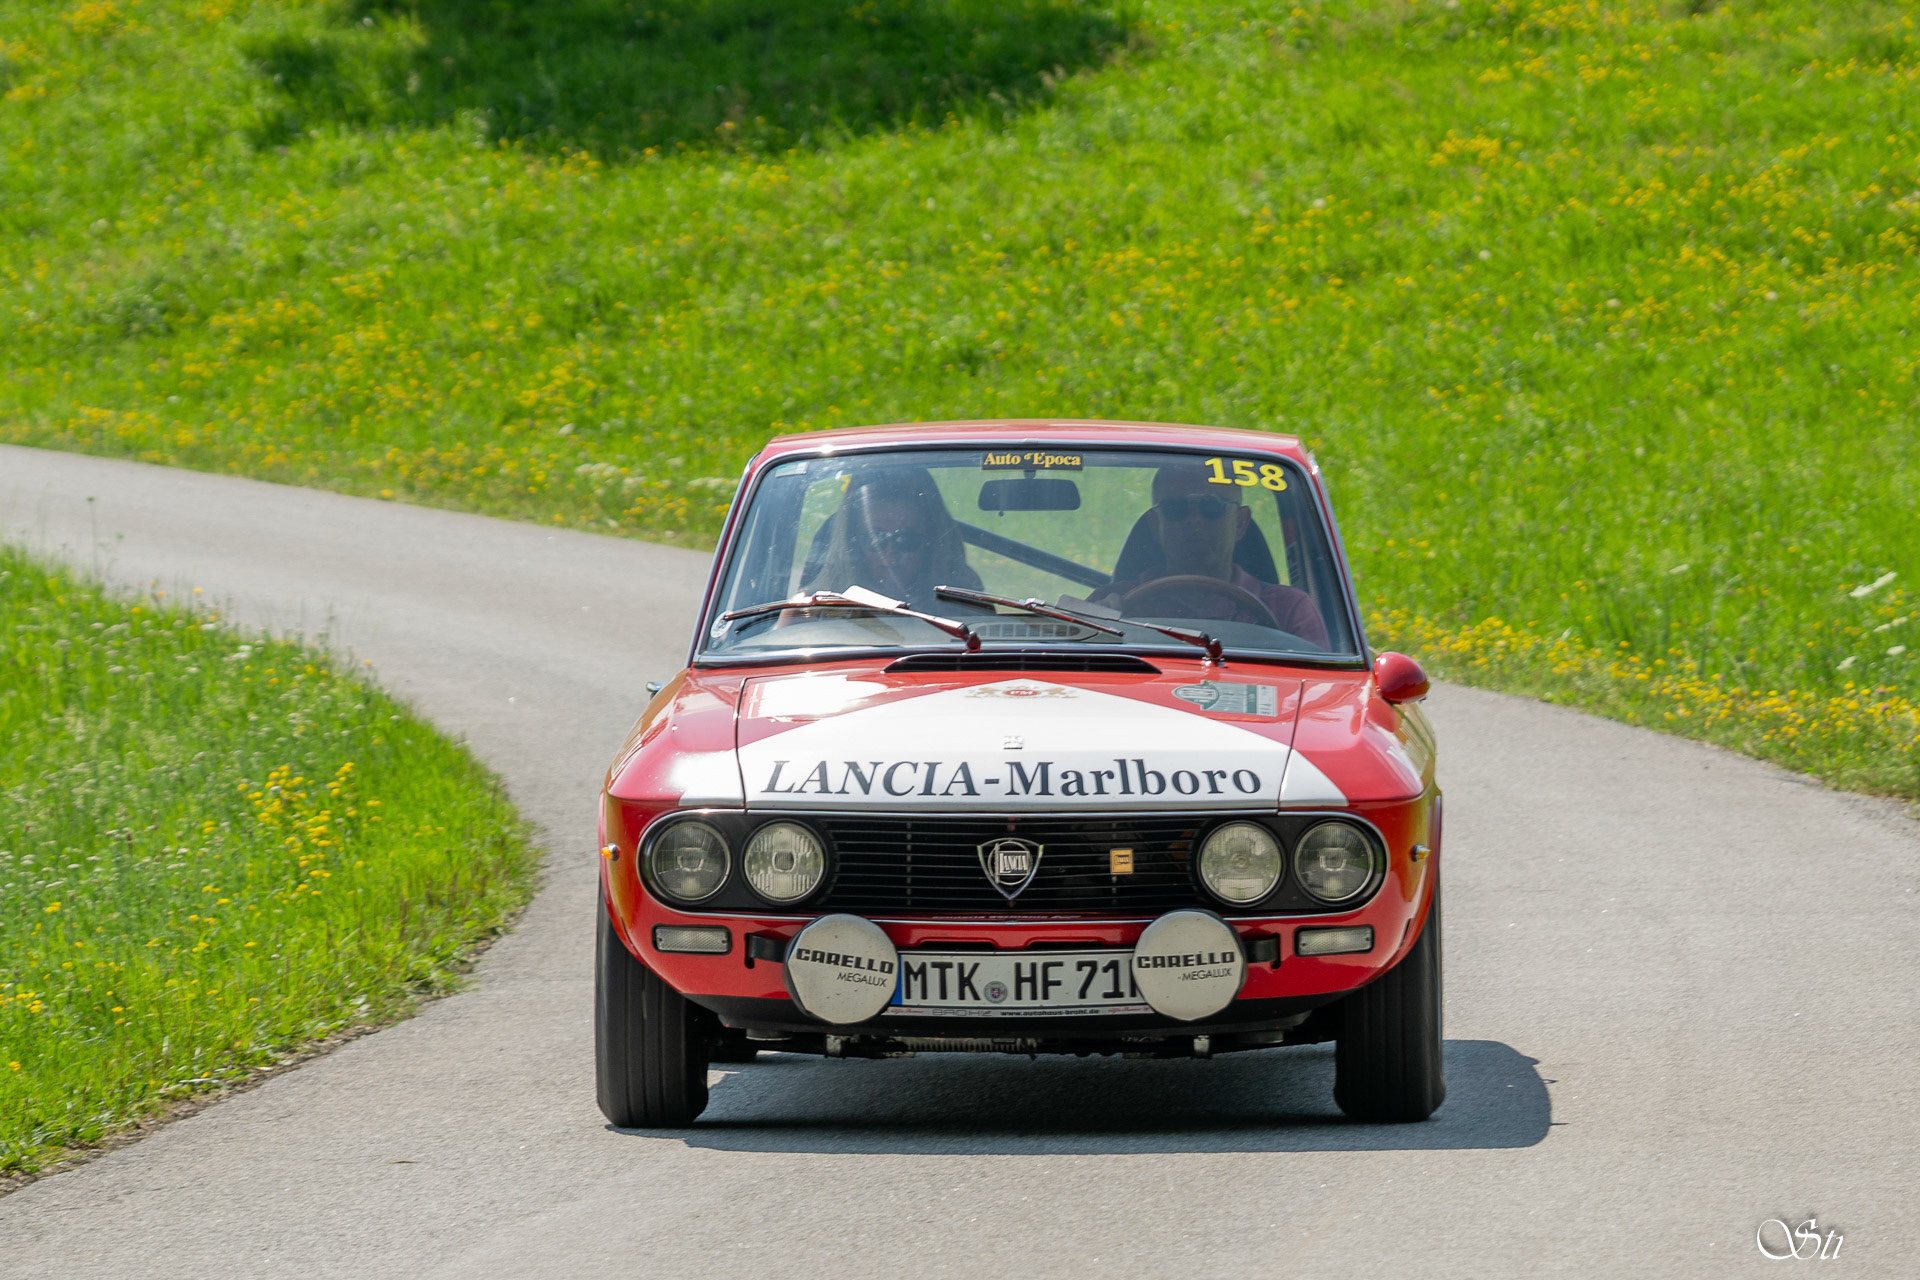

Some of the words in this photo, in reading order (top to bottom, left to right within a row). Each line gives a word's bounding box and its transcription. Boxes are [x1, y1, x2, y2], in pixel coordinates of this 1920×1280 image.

[983, 452, 1021, 465] Auto
[1204, 457, 1288, 492] 158
[760, 758, 1262, 797] LANCIA-Marlboro
[796, 948, 894, 974] CARELLO
[1137, 951, 1235, 968] CARELLO
[837, 973, 887, 987] MEGALUX
[903, 961, 981, 1000] MTK
[1014, 961, 1064, 1000] HF
[1182, 968, 1233, 981] MEGALUX
